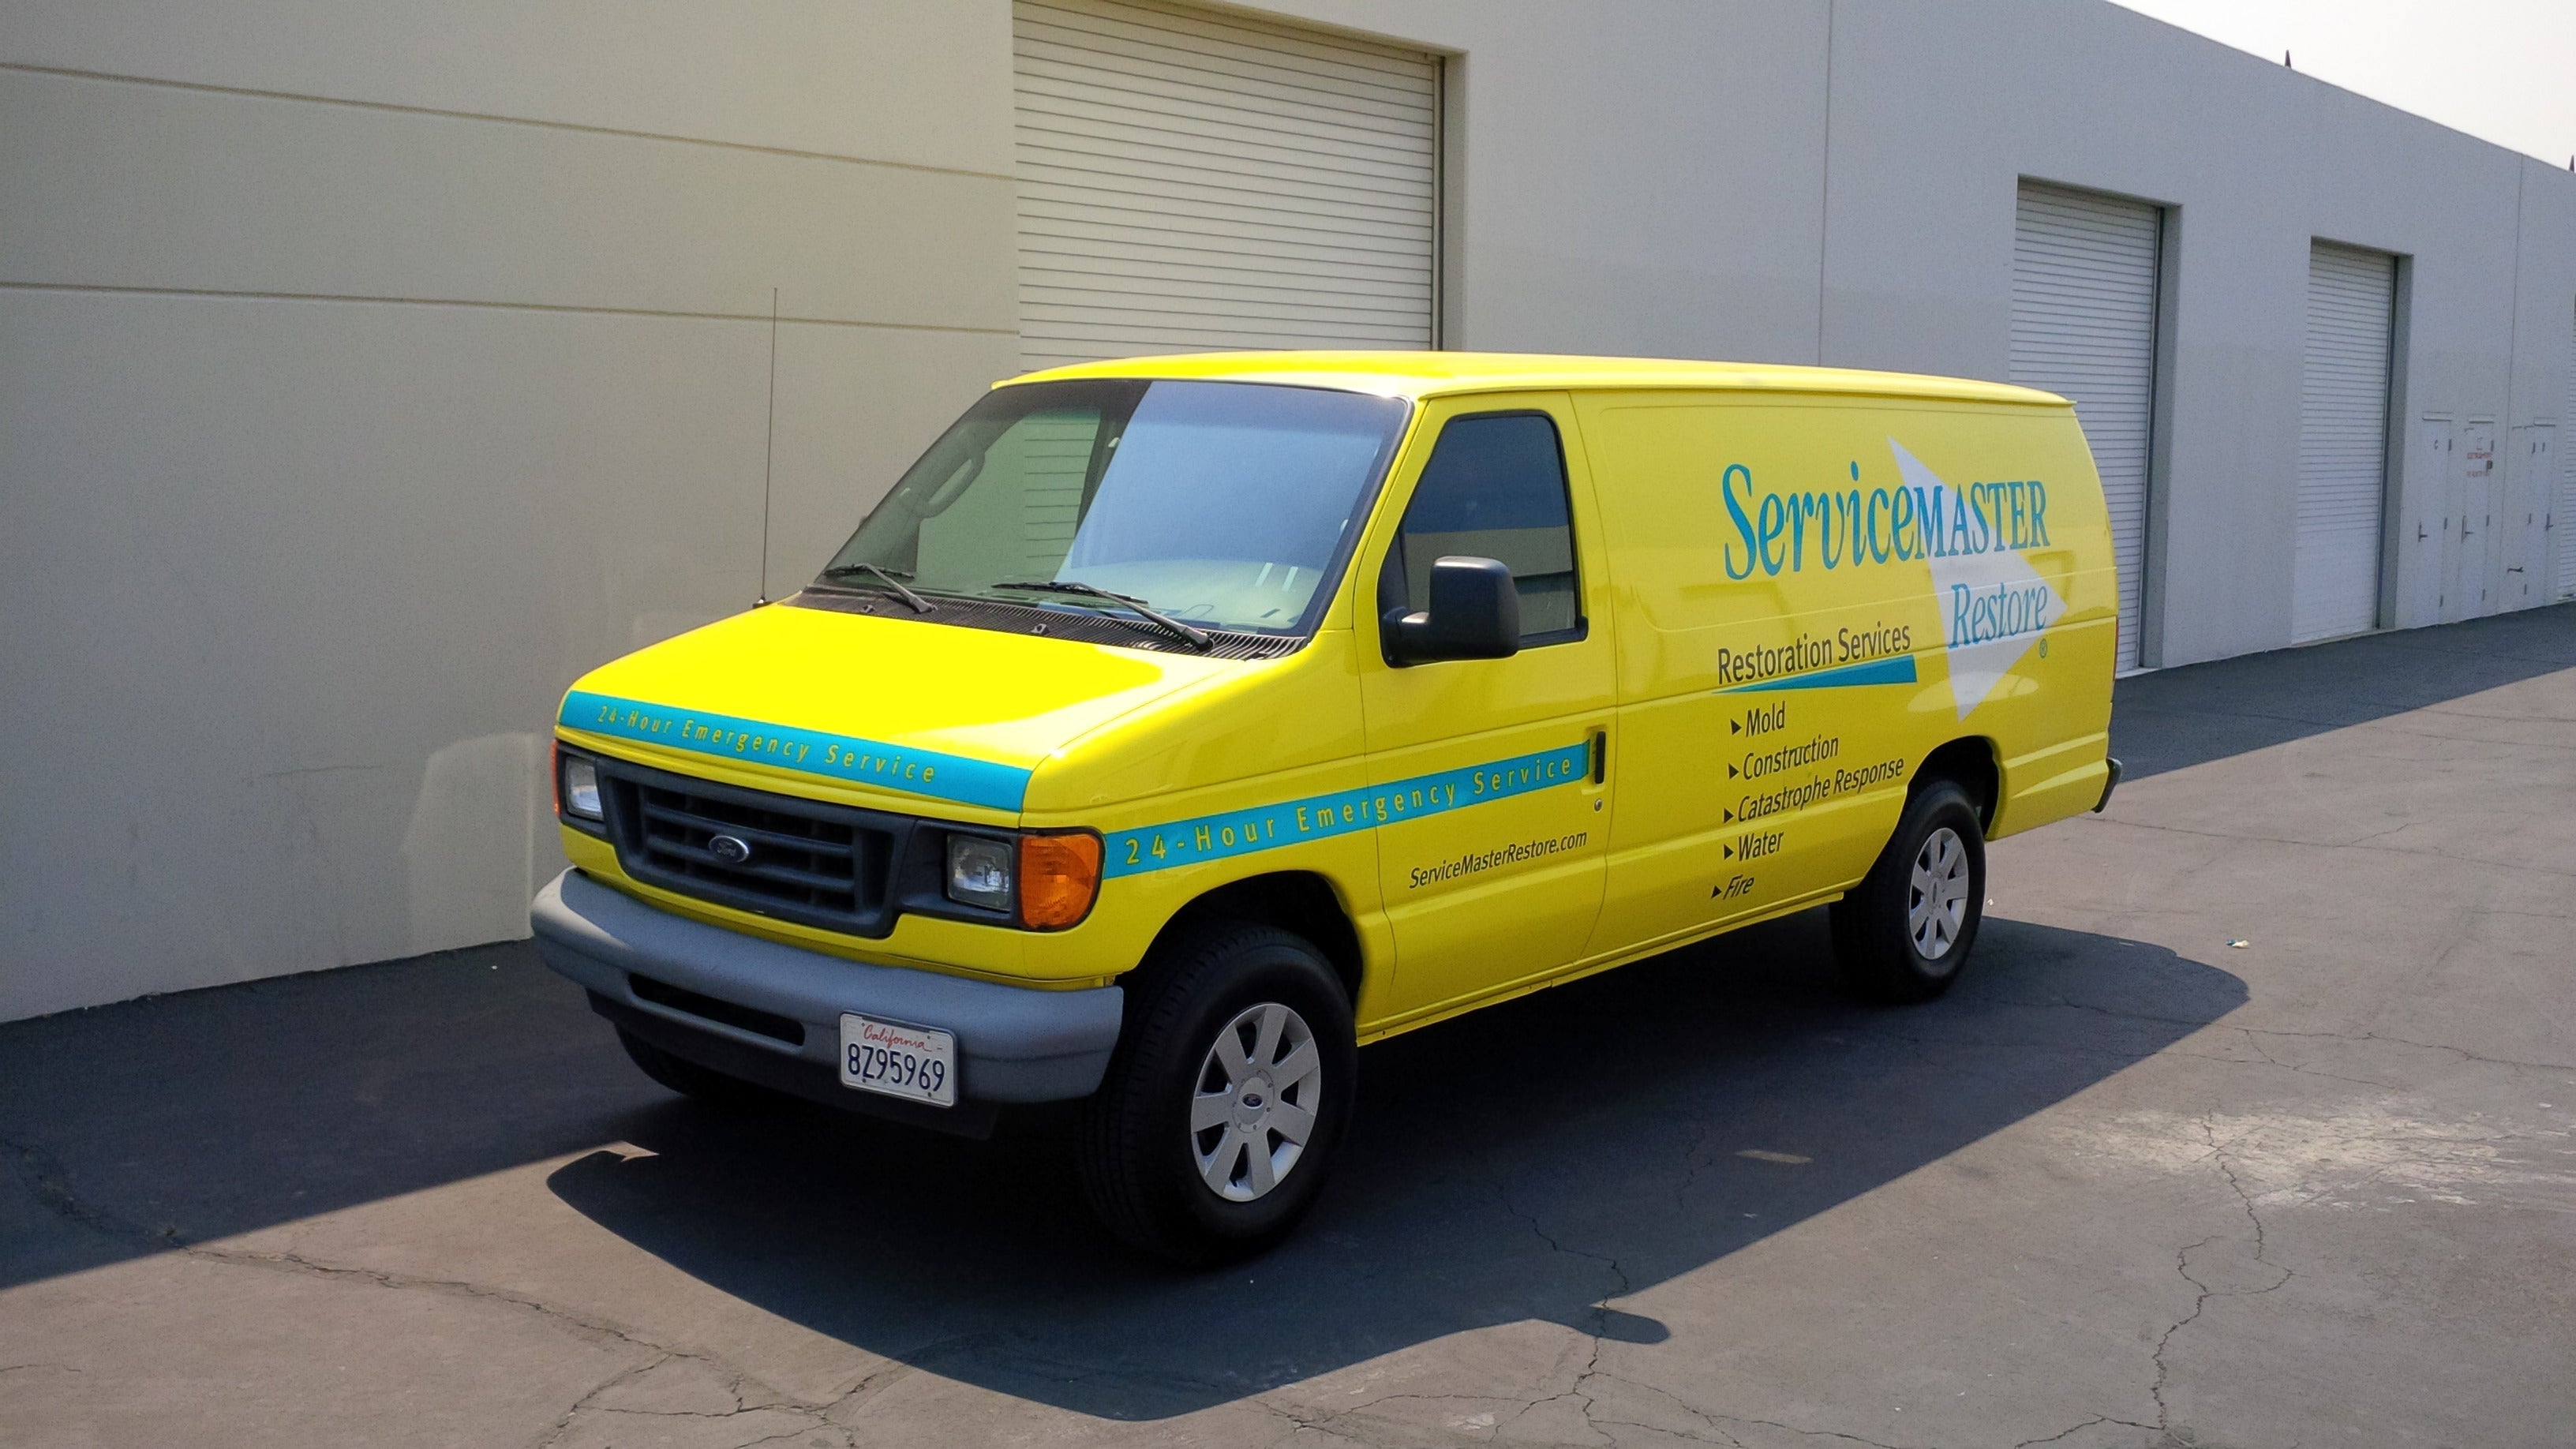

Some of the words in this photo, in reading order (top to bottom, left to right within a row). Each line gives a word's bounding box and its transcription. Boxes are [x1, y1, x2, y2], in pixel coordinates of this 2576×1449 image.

[1948, 581, 2048, 650] Restore
[1717, 632, 1833, 685] Restoration
[1837, 621, 1911, 662] Services
[597, 705, 672, 735] 24-Hour
[682, 719, 810, 763] Emergency
[825, 743, 936, 783] Service
[1745, 700, 1786, 738] Mold
[1743, 734, 1839, 781] Construction
[1125, 819, 1275, 866] 24-Hour
[1297, 780, 1458, 833] Emergency
[1473, 755, 1572, 794] Service
[1738, 775, 1830, 822] Catastrophe
[1833, 758, 1904, 796] Response
[1409, 831, 1588, 889] ServiceMasterRestore.com
[1738, 831, 1784, 862] Water
[1722, 874, 1754, 900] Fire
[863, 1024, 933, 1052] California
[848, 1043, 945, 1092] 8Z95969
